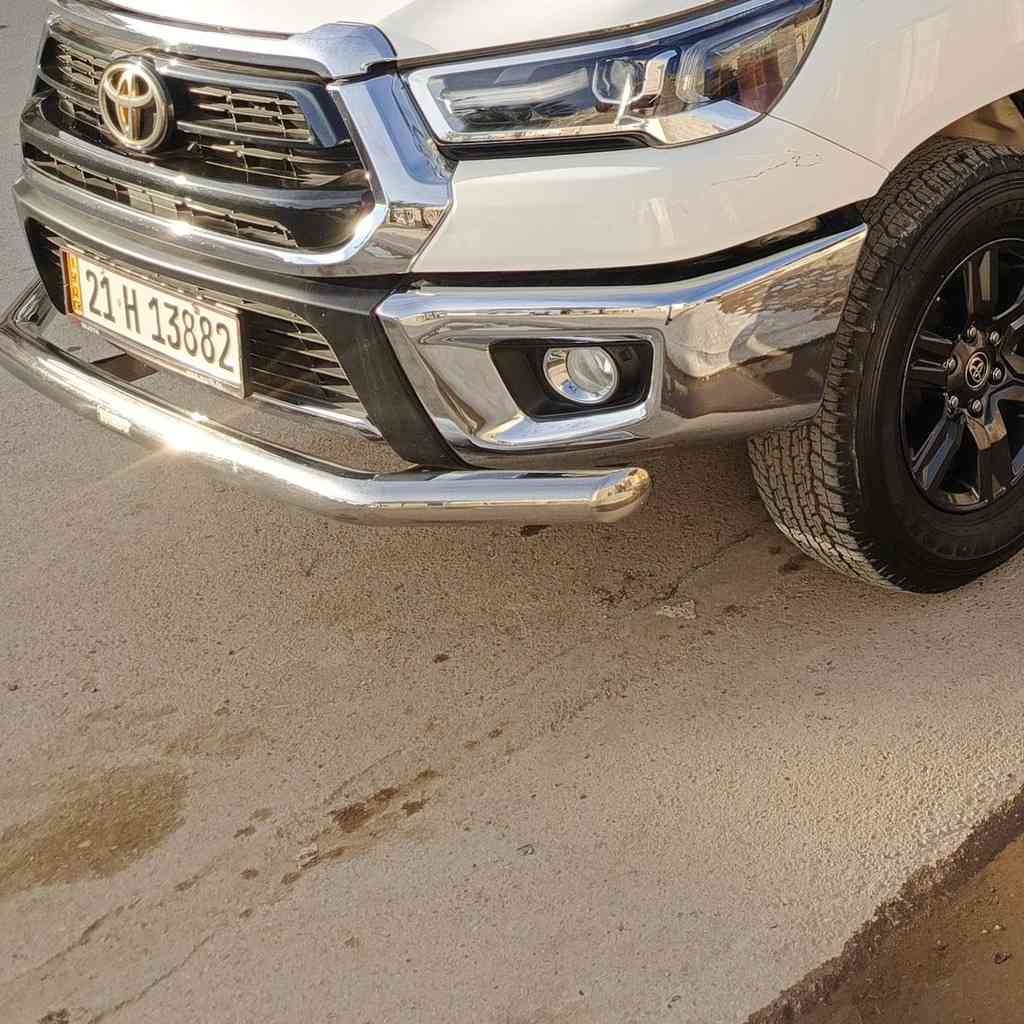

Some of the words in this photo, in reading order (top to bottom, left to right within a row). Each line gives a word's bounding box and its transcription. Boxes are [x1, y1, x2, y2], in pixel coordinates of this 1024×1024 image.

[86, 270, 116, 323] 21
[123, 285, 141, 334] H
[149, 297, 235, 372] 13882
